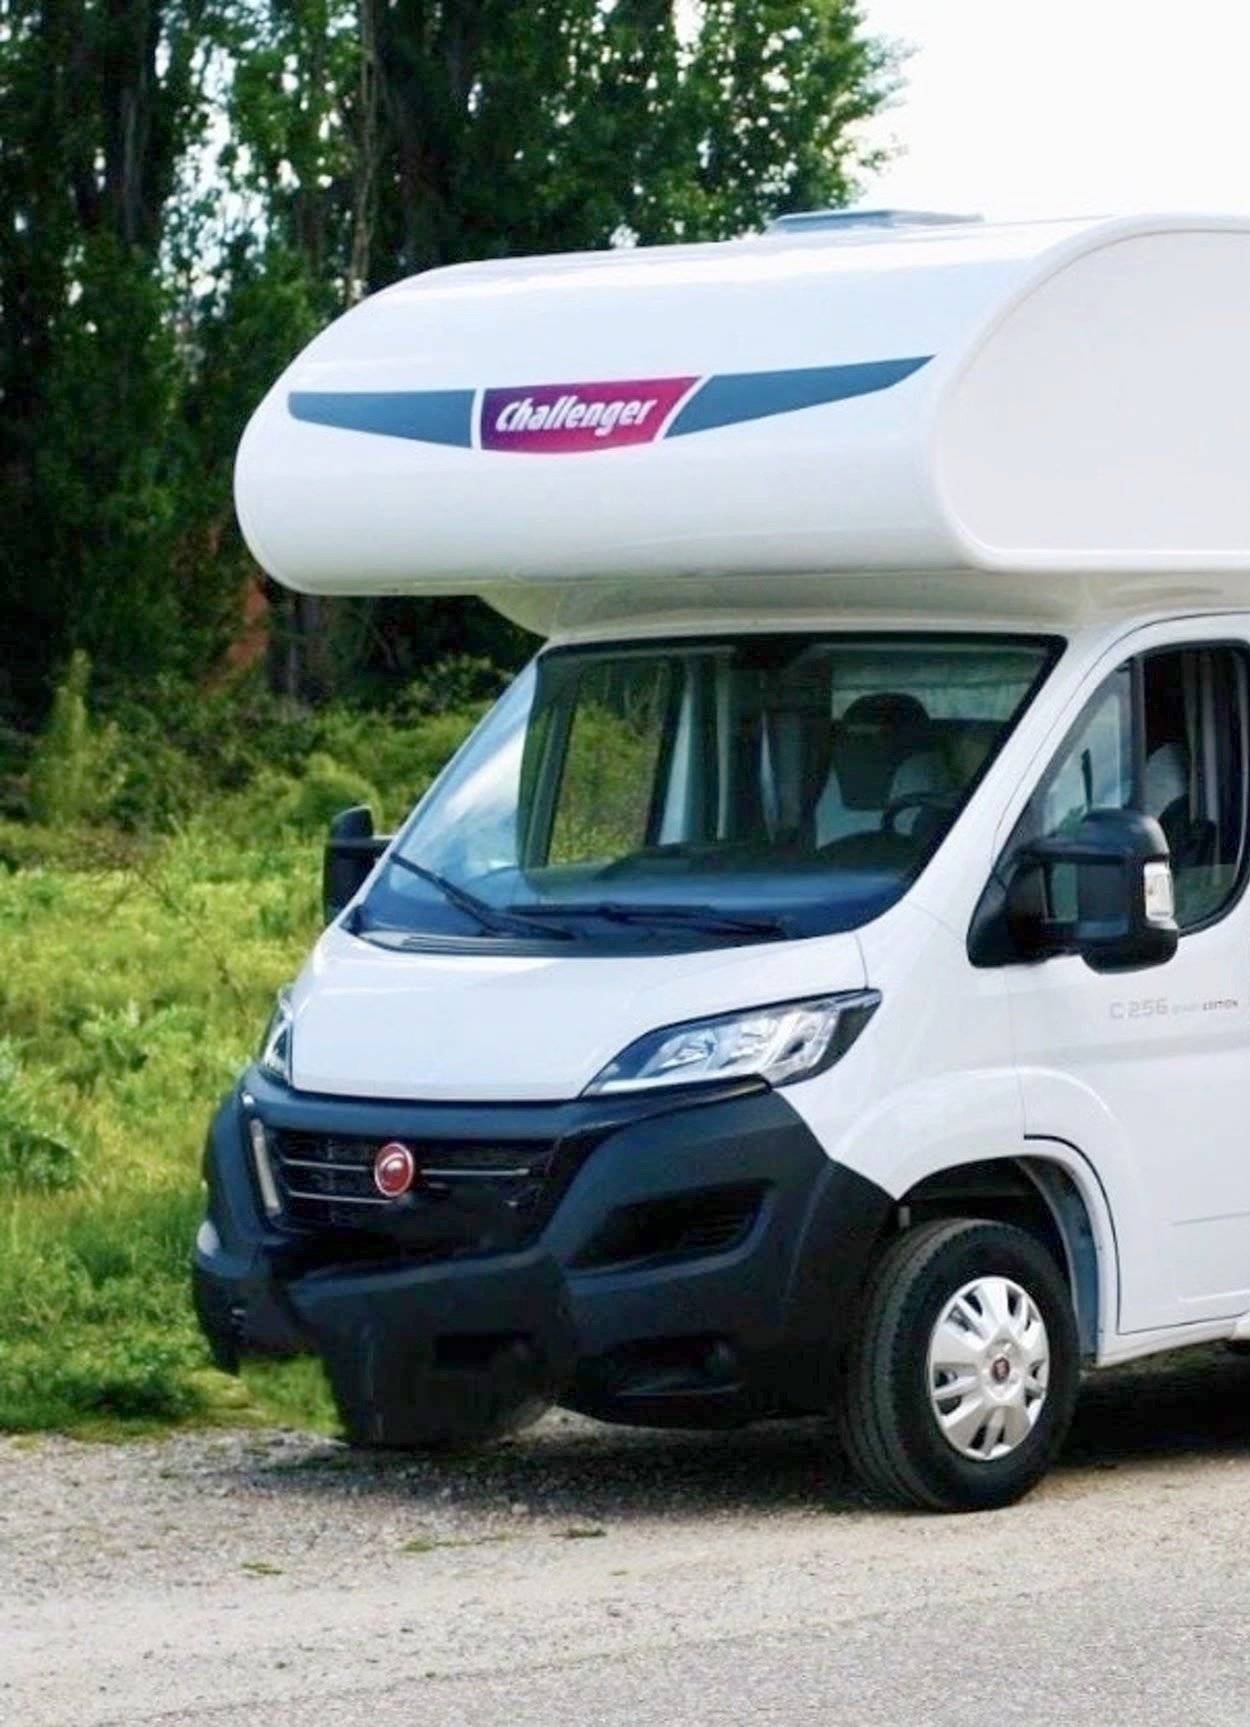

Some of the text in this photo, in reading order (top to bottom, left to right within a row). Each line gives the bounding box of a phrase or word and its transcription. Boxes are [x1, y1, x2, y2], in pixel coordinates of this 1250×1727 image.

[495, 395, 657, 437] Challenger
[1110, 1002, 1124, 1019] C
[1127, 998, 1169, 1018] 256
